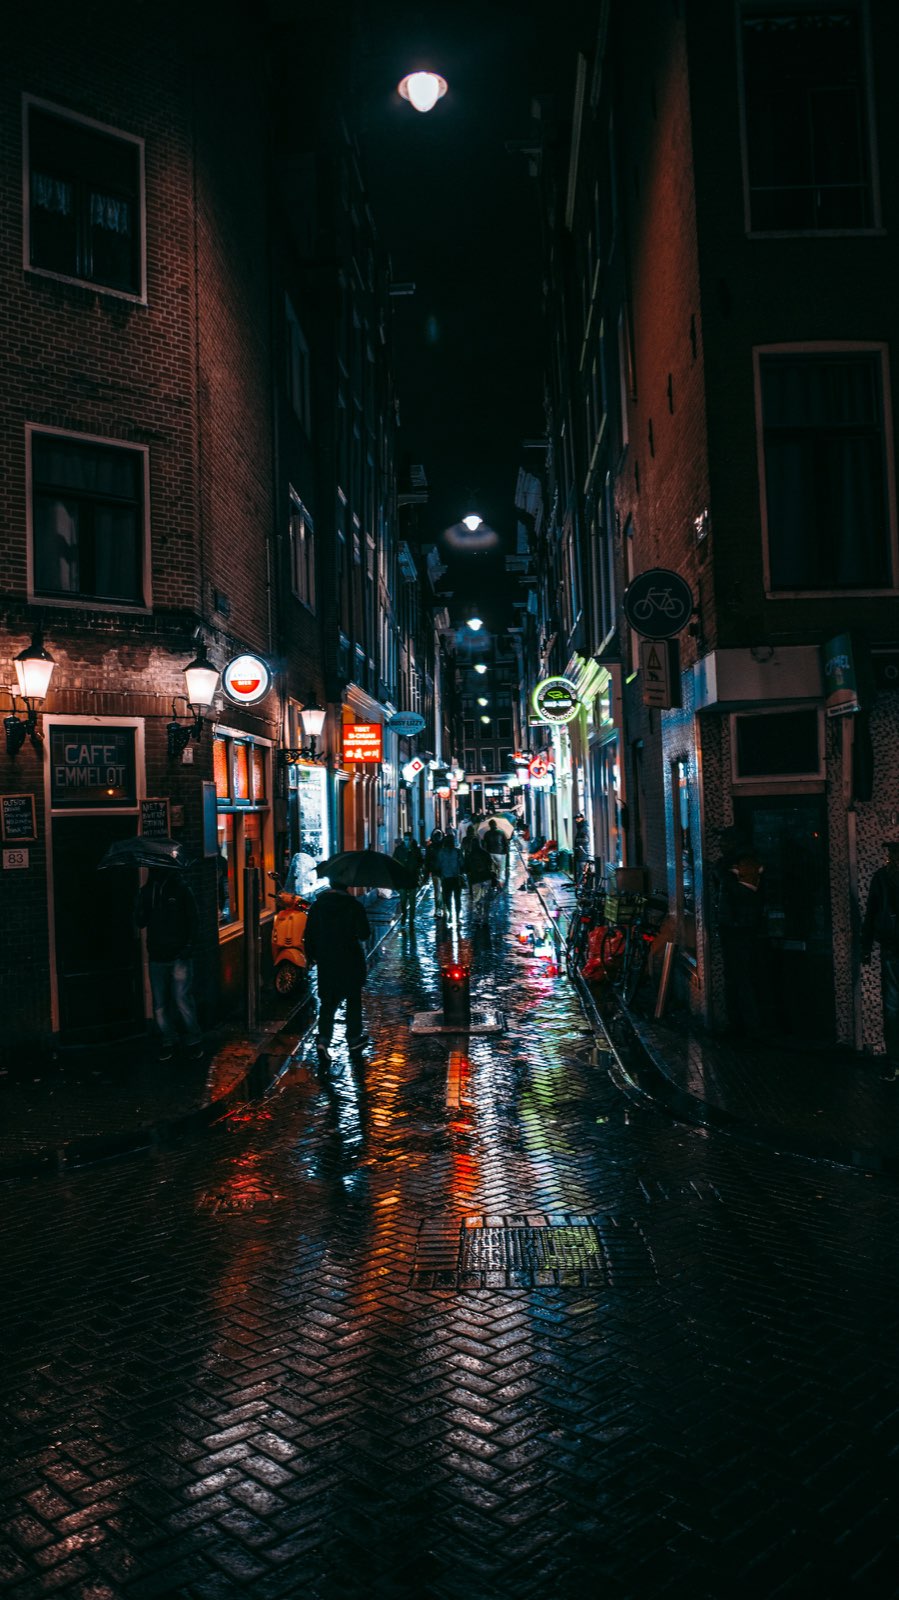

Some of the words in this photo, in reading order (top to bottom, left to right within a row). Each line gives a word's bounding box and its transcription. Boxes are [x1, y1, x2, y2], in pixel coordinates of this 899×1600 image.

[64, 744, 115, 765] CAFE
[55, 766, 126, 787] EMMELOT
[8, 853, 24, 864] 83
